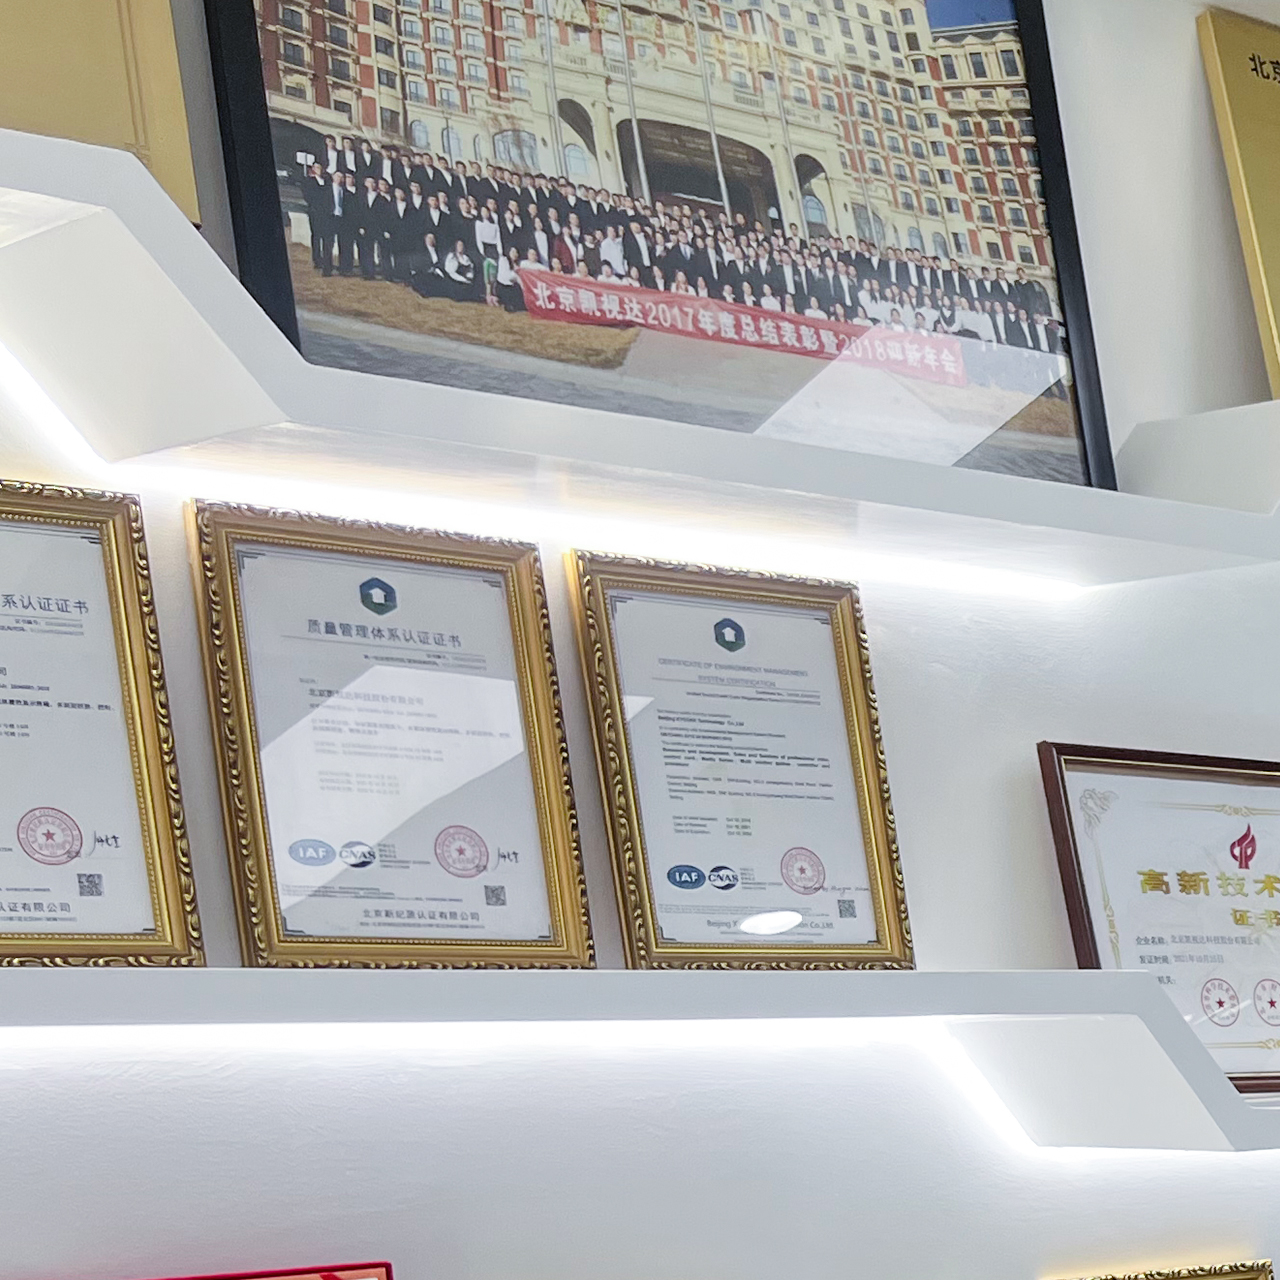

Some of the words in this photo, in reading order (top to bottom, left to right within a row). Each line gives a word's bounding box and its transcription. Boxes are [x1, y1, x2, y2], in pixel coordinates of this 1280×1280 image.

[307, 618, 462, 648] 质量管理体系认证证书
[299, 847, 327, 859] IAF
[339, 849, 377, 861] CNAS
[675, 872, 699, 882] IAF
[708, 873, 739, 883] CNAS
